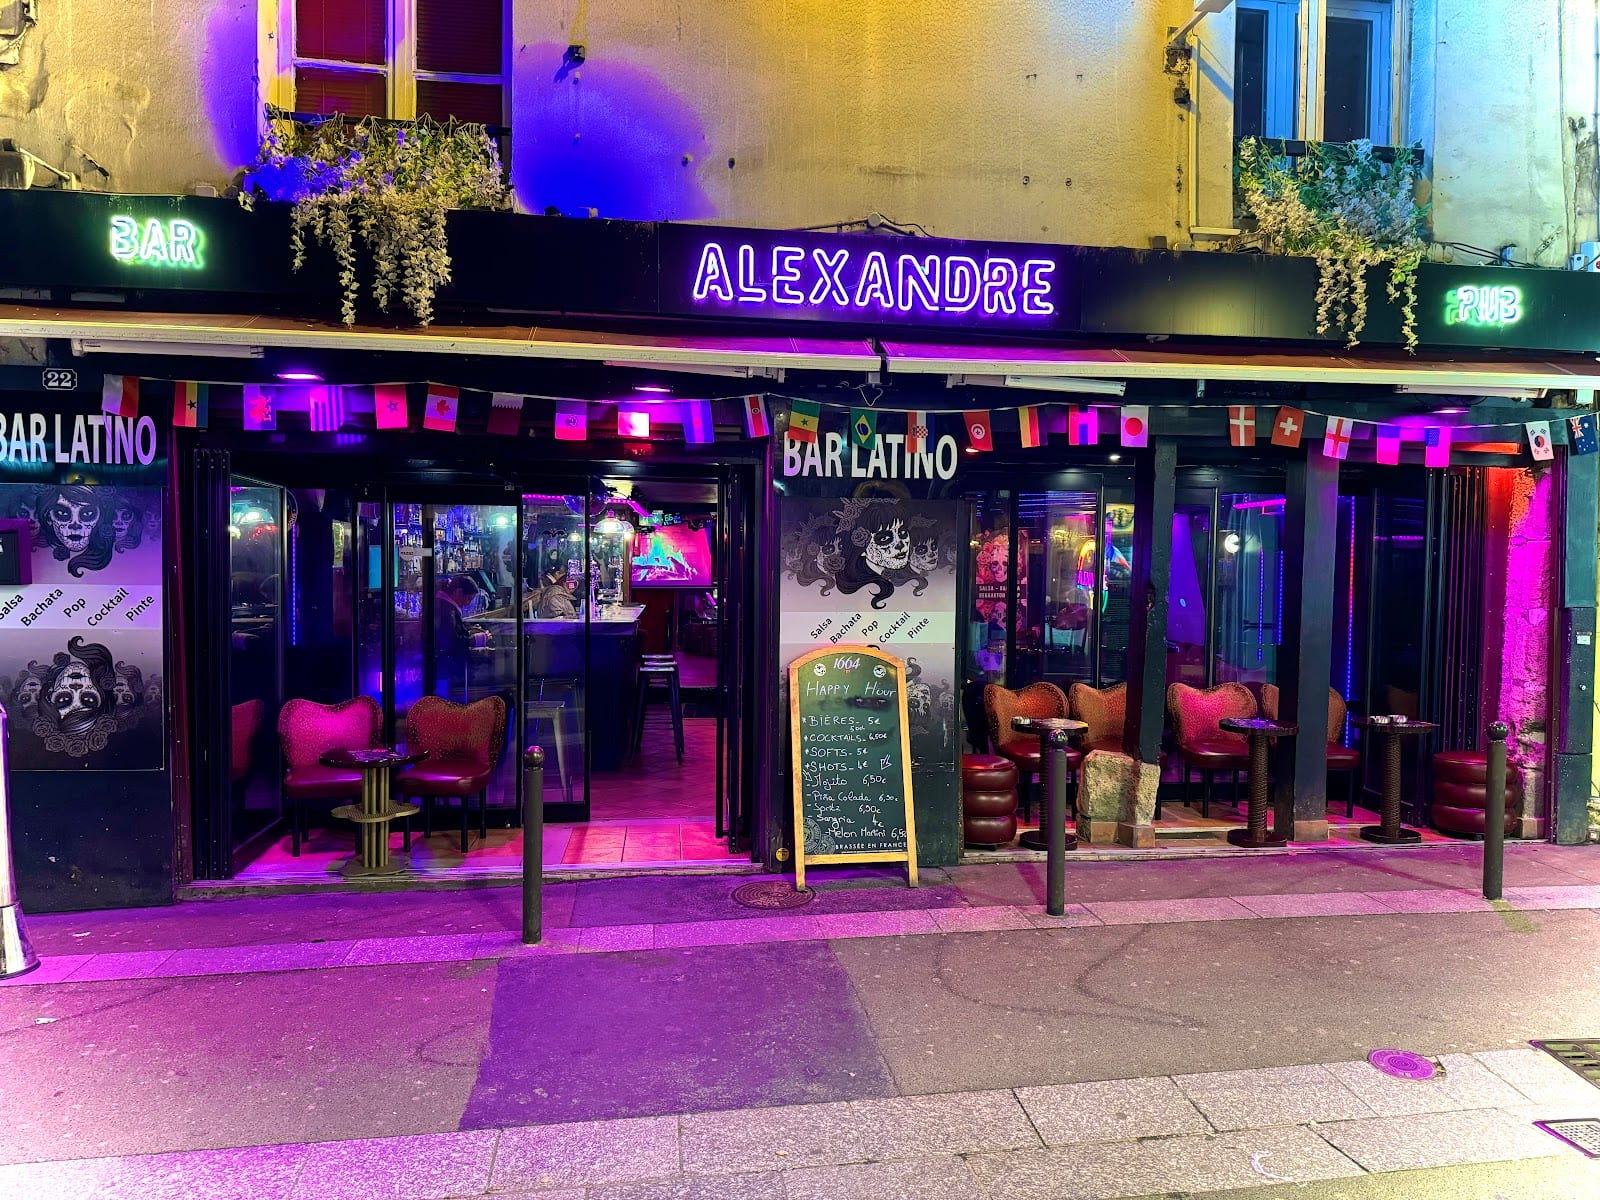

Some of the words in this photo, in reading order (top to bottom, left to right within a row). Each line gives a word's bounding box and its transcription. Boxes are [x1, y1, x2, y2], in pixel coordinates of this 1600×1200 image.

[109, 214, 197, 263] BAR
[693, 242, 1055, 315] ALEXANDRE
[1457, 285, 1522, 323] PUB
[47, 371, 72, 387] 22
[54, 412, 157, 466] LATINO
[783, 430, 844, 478] BAR
[851, 432, 959, 481] LATINO
[20, 587, 64, 627] Bachata
[63, 597, 86, 618] Pop
[87, 587, 129, 627] Cocktail
[125, 595, 155, 622] Pinte
[810, 617, 833, 639] Salsa
[829, 612, 862, 645] Bachata
[861, 619, 879, 637] Pop
[879, 610, 911, 643] Cocktail
[907, 617, 930, 639] Pinte
[833, 656, 860, 669] 1664
[838, 791, 871, 801] Colada
